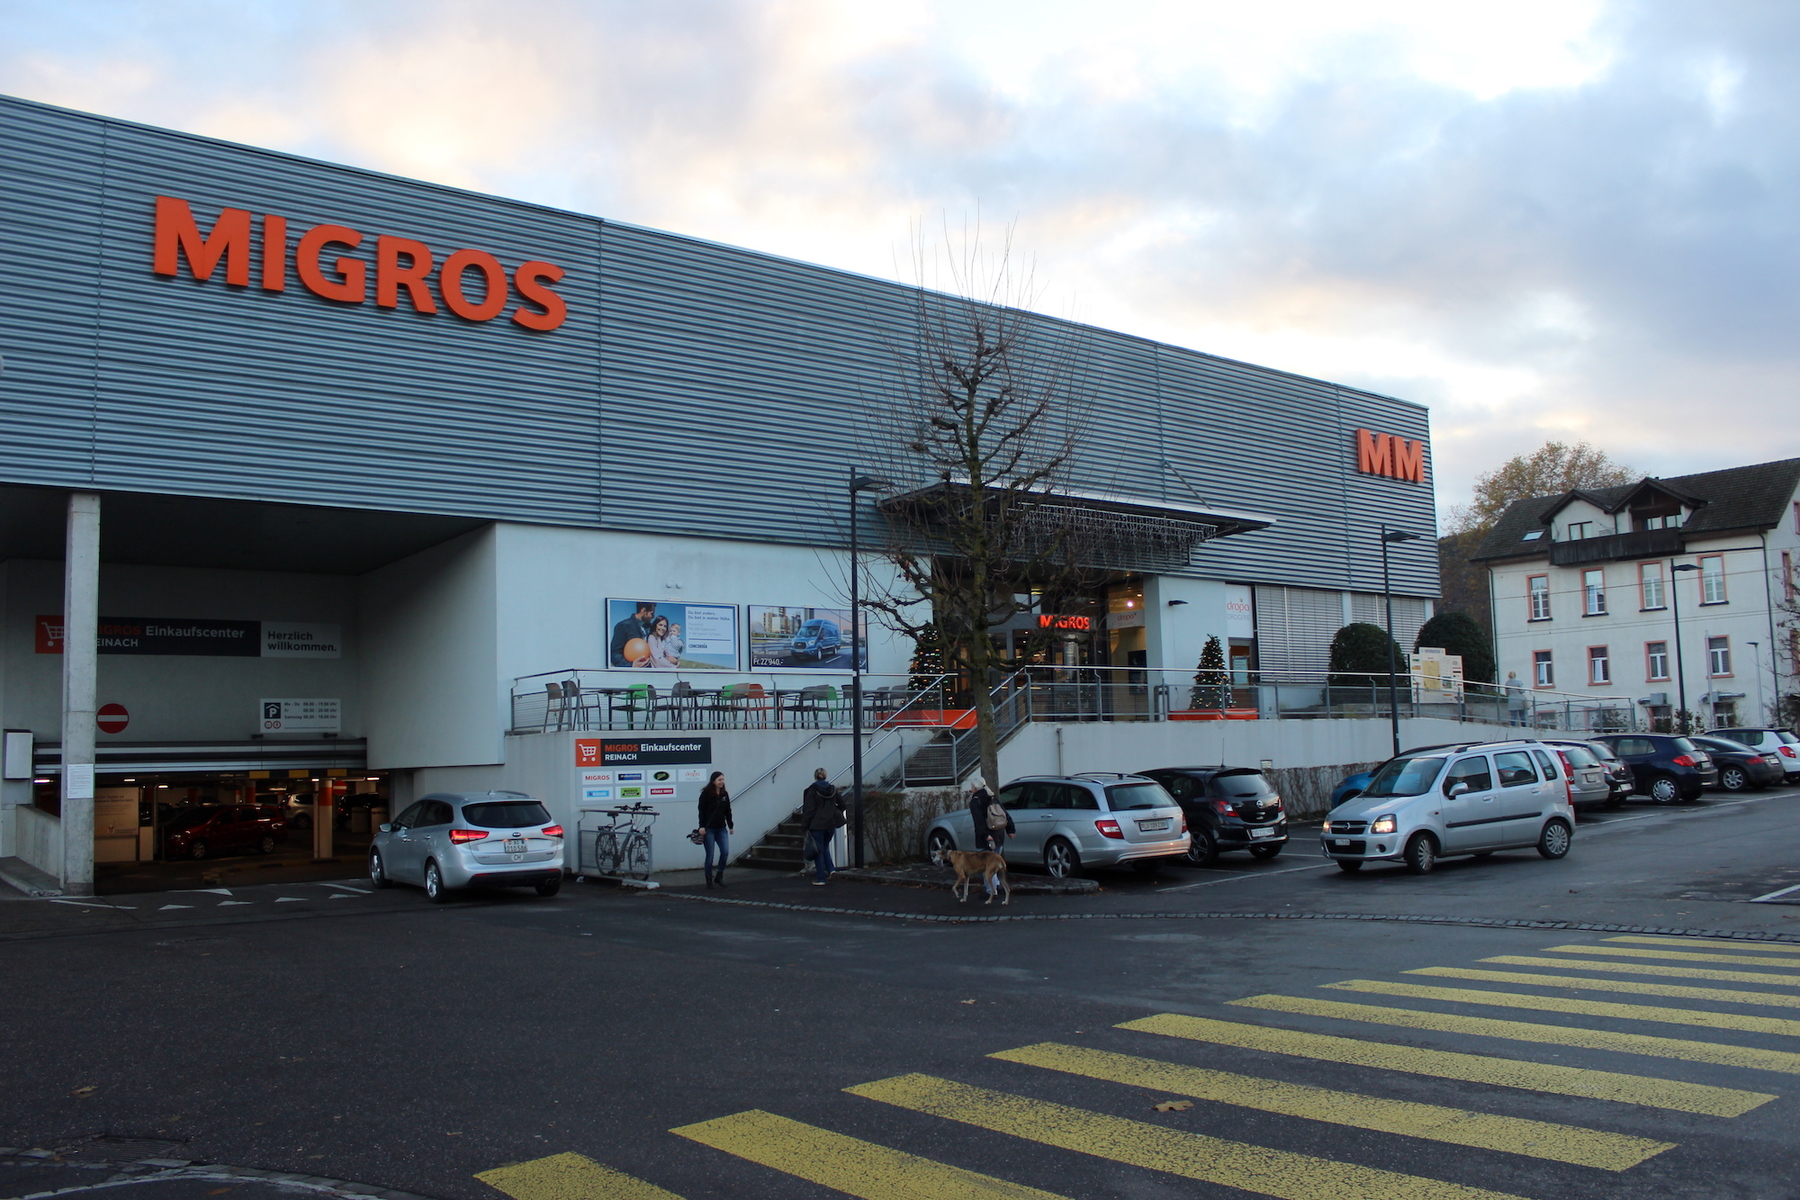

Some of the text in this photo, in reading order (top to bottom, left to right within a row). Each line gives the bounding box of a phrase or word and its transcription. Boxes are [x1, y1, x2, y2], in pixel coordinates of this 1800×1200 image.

[153, 195, 567, 332] MIGROS
[1356, 428, 1425, 483] MM
[1227, 601, 1250, 613] dropa
[98, 625, 245, 639] IGROS Einkaufscenter
[268, 631, 313, 641] Herzlich
[97, 638, 139, 647] EINACH
[268, 642, 337, 652] willkommen.
[269, 707, 277, 718] P
[604, 743, 701, 752] MIGROS Einkaufscenter
